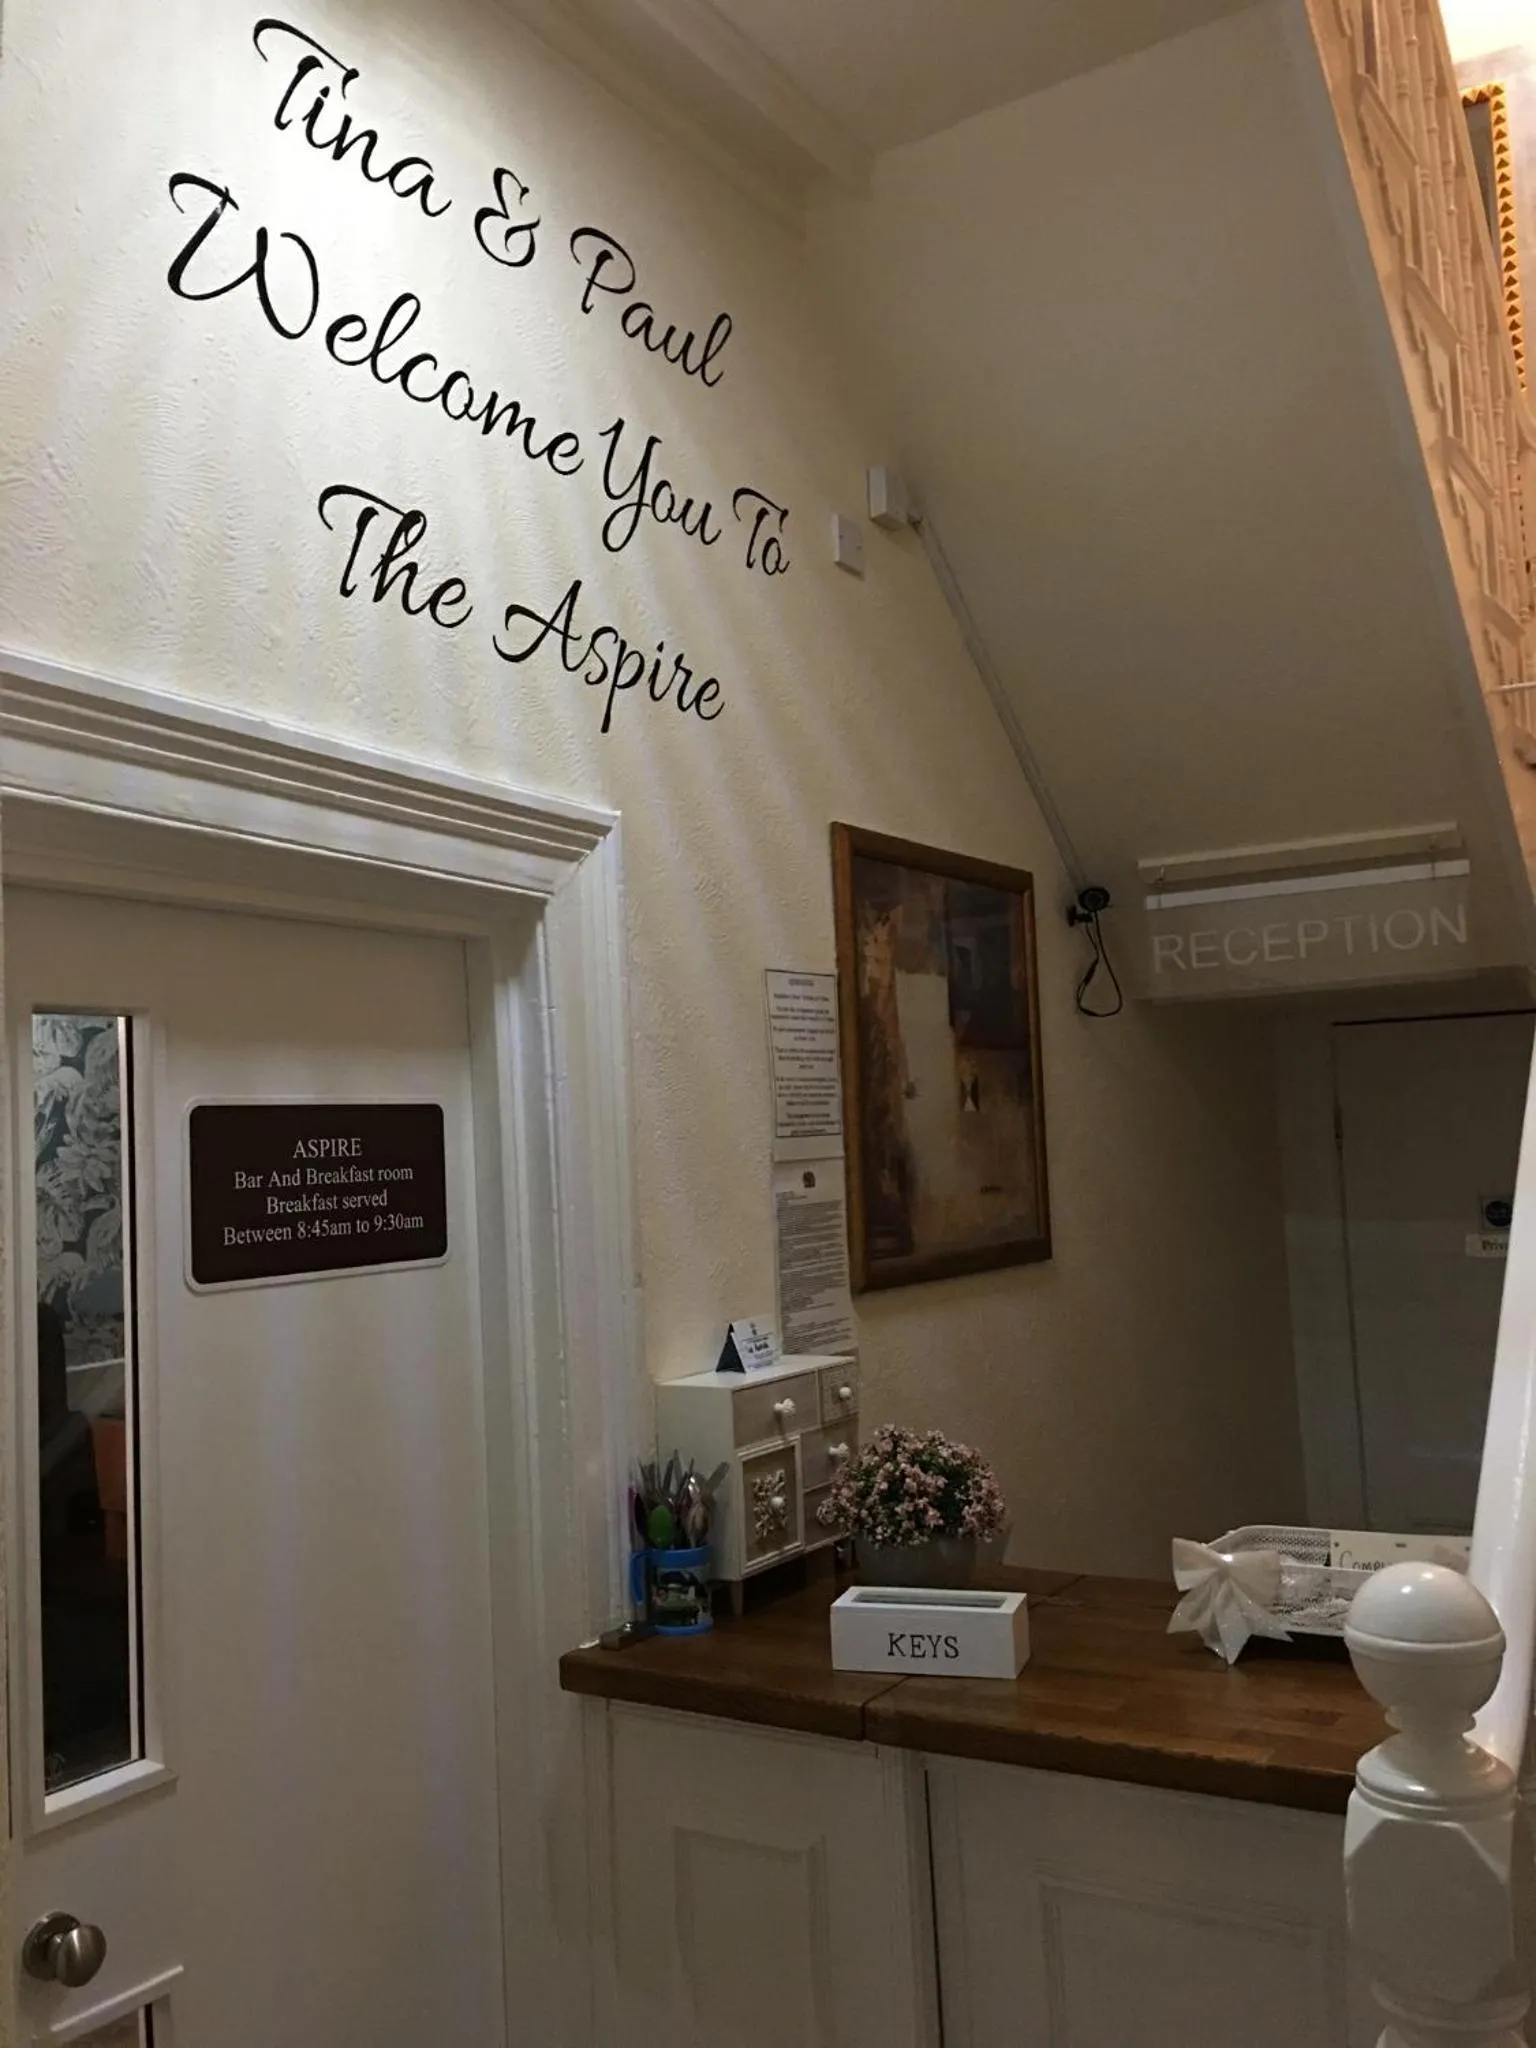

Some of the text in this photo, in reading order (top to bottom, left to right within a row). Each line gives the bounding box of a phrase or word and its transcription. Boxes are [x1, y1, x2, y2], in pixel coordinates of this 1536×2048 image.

[253, 19, 733, 388] Tina & Paul
[166, 172, 790, 575] Welcome You To
[318, 484, 724, 733] The Aspire
[1151, 902, 1468, 974] RECEPTION
[292, 1138, 363, 1159] ASPIRE
[234, 1165, 414, 1189] Bar And Breakfast room
[266, 1190, 388, 1214] Breakfast served
[223, 1213, 424, 1246] Between 8:45am to 9:30am
[886, 1632, 960, 1660] KEYS
